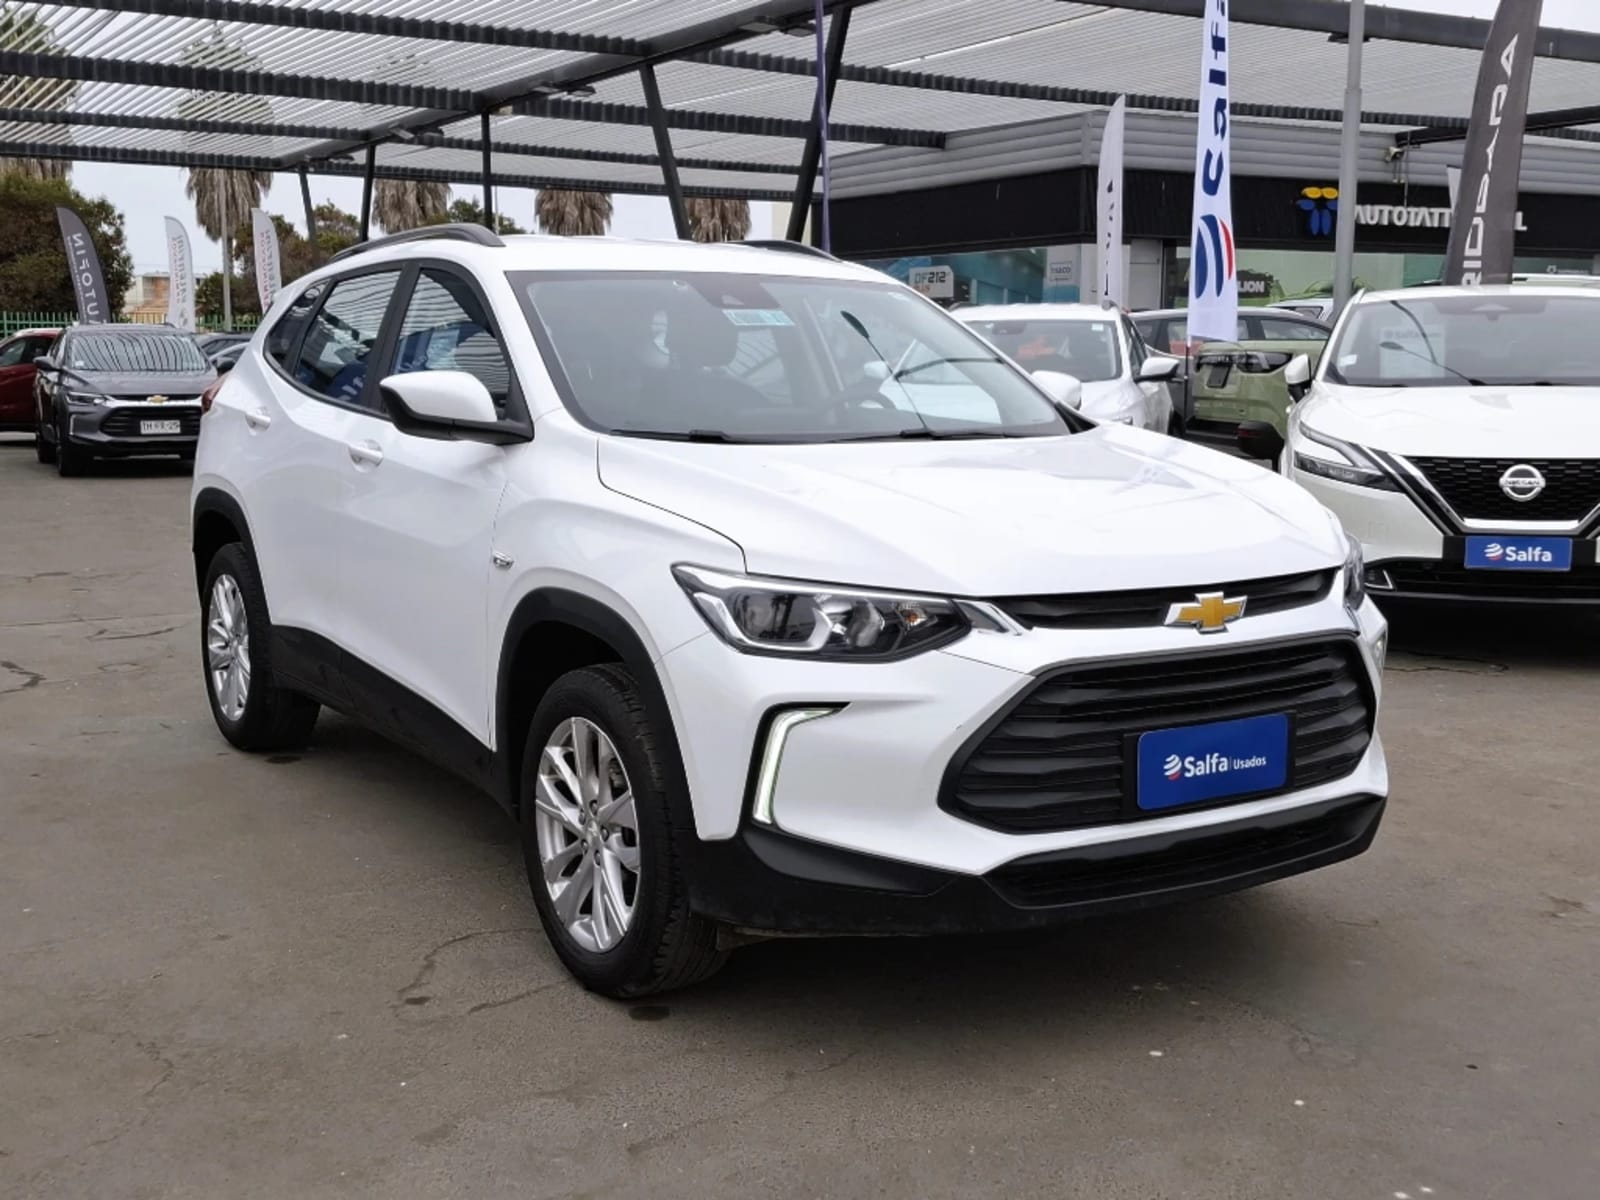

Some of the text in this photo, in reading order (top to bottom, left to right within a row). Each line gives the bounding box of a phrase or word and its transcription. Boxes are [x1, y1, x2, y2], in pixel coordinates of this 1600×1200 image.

[1505, 547, 1552, 562] Salfa
[1184, 752, 1267, 778] Salfa Usados
